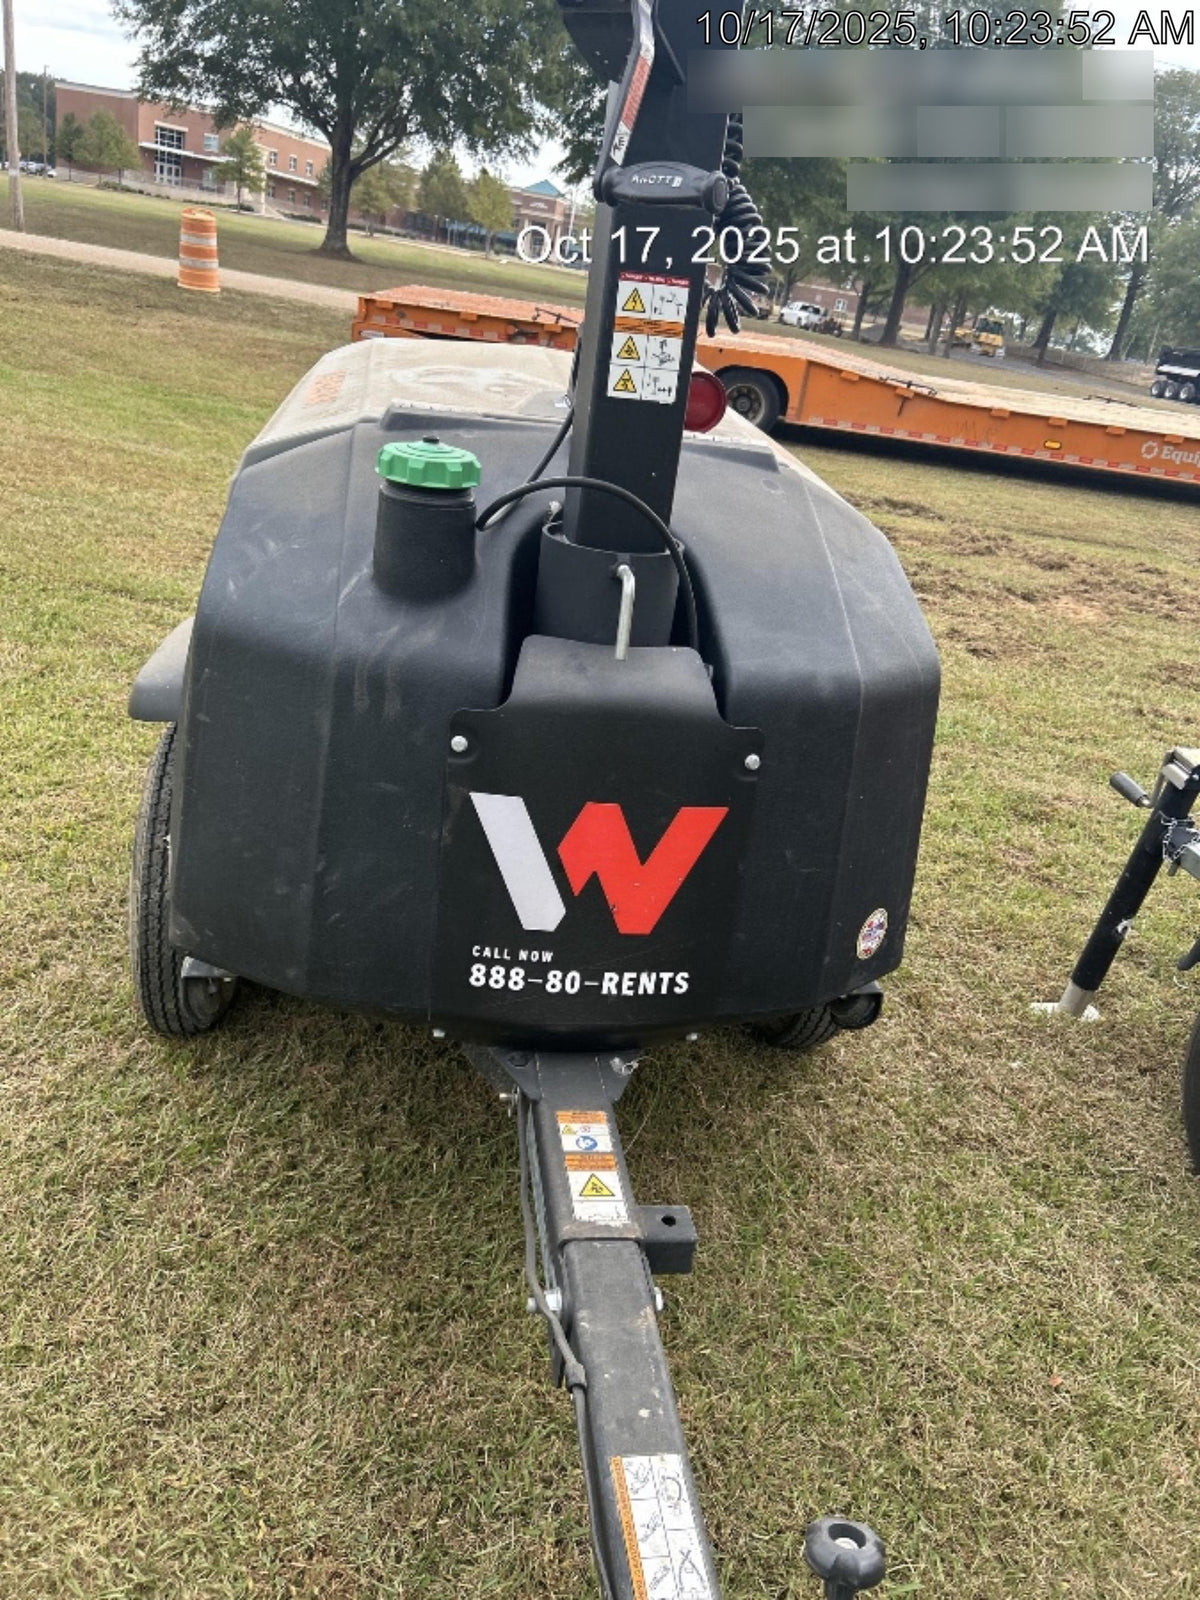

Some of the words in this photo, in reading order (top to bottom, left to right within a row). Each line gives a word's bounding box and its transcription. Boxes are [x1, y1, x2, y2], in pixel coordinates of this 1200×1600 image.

[471, 945, 512, 961] CALL
[518, 949, 554, 963] NOW
[468, 963, 690, 996] 888-80-RENTS
